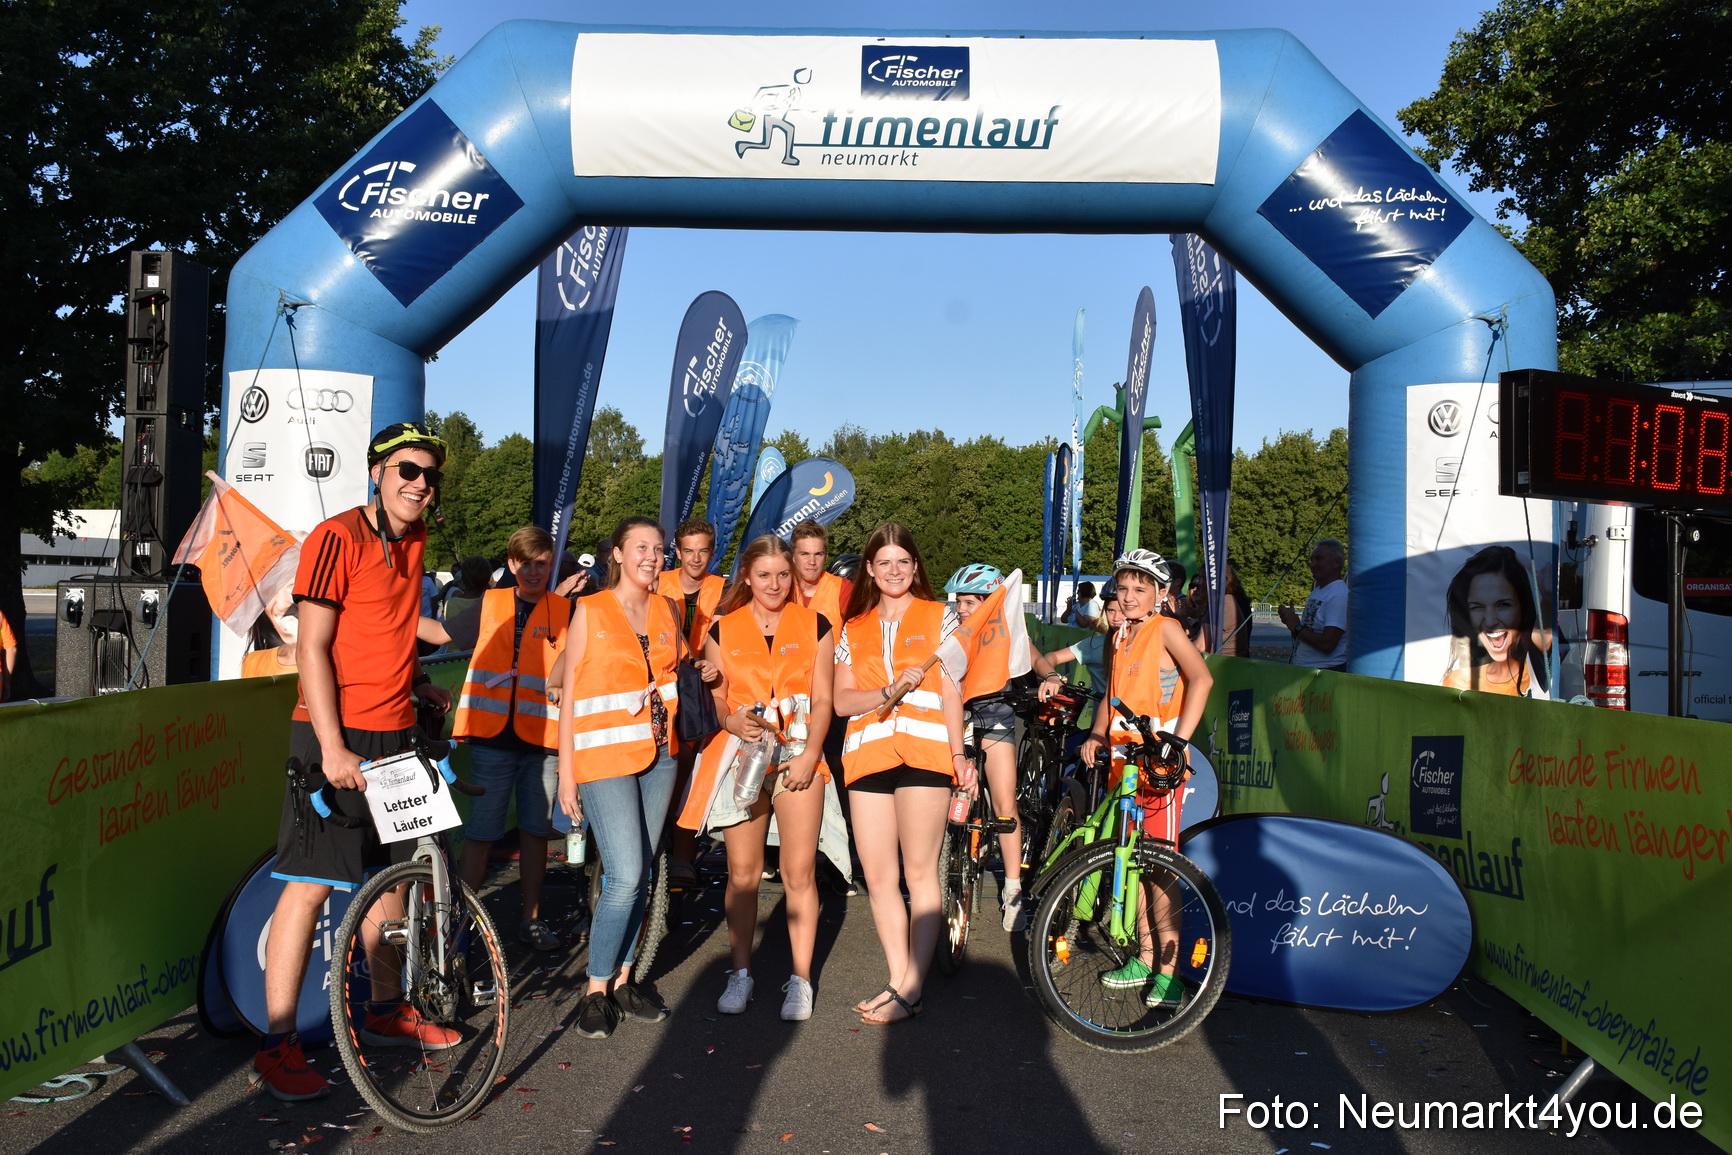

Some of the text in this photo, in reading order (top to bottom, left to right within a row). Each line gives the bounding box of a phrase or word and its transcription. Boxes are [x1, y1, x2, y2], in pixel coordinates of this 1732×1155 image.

[885, 65, 963, 79] Fischer
[821, 104, 1063, 149] firmenlauf
[821, 150, 919, 166] neumarkt
[360, 182, 490, 211] Fischer
[1308, 192, 1343, 211] und
[1349, 186, 1383, 203] das
[1386, 187, 1447, 204] Lächeln
[369, 208, 478, 225] AUTOMOBILE
[1354, 208, 1446, 231] fährt mit!
[570, 226, 598, 288] Fisc
[592, 226, 609, 282] AUTOM
[693, 316, 728, 402] Fischer
[708, 330, 734, 398] AUTOMOBILE
[308, 454, 332, 471] FIAT
[235, 474, 274, 482] SEAT
[771, 498, 821, 538] hmann
[813, 489, 848, 519] und Medien
[1694, 694, 1726, 705] official
[47, 712, 228, 806] Gesunde Firmen
[1508, 739, 1702, 795] Gesunde Firmen
[1419, 766, 1454, 785] Fischer
[100, 741, 246, 846] laufen länger!
[384, 794, 428, 813] Letzter
[1422, 786, 1451, 795] AUTOMOBILE
[393, 816, 433, 833] Läufer
[1545, 798, 1621, 853] laufen
[1088, 850, 1113, 864] SCHWAL
[1226, 892, 1257, 918] nd
[1265, 888, 1312, 916] das
[1318, 891, 1428, 916] Lächeln
[1270, 922, 1417, 954] fährt mit!
[1484, 938, 1709, 1096] www.firmenlauf-oberpfalz.de
